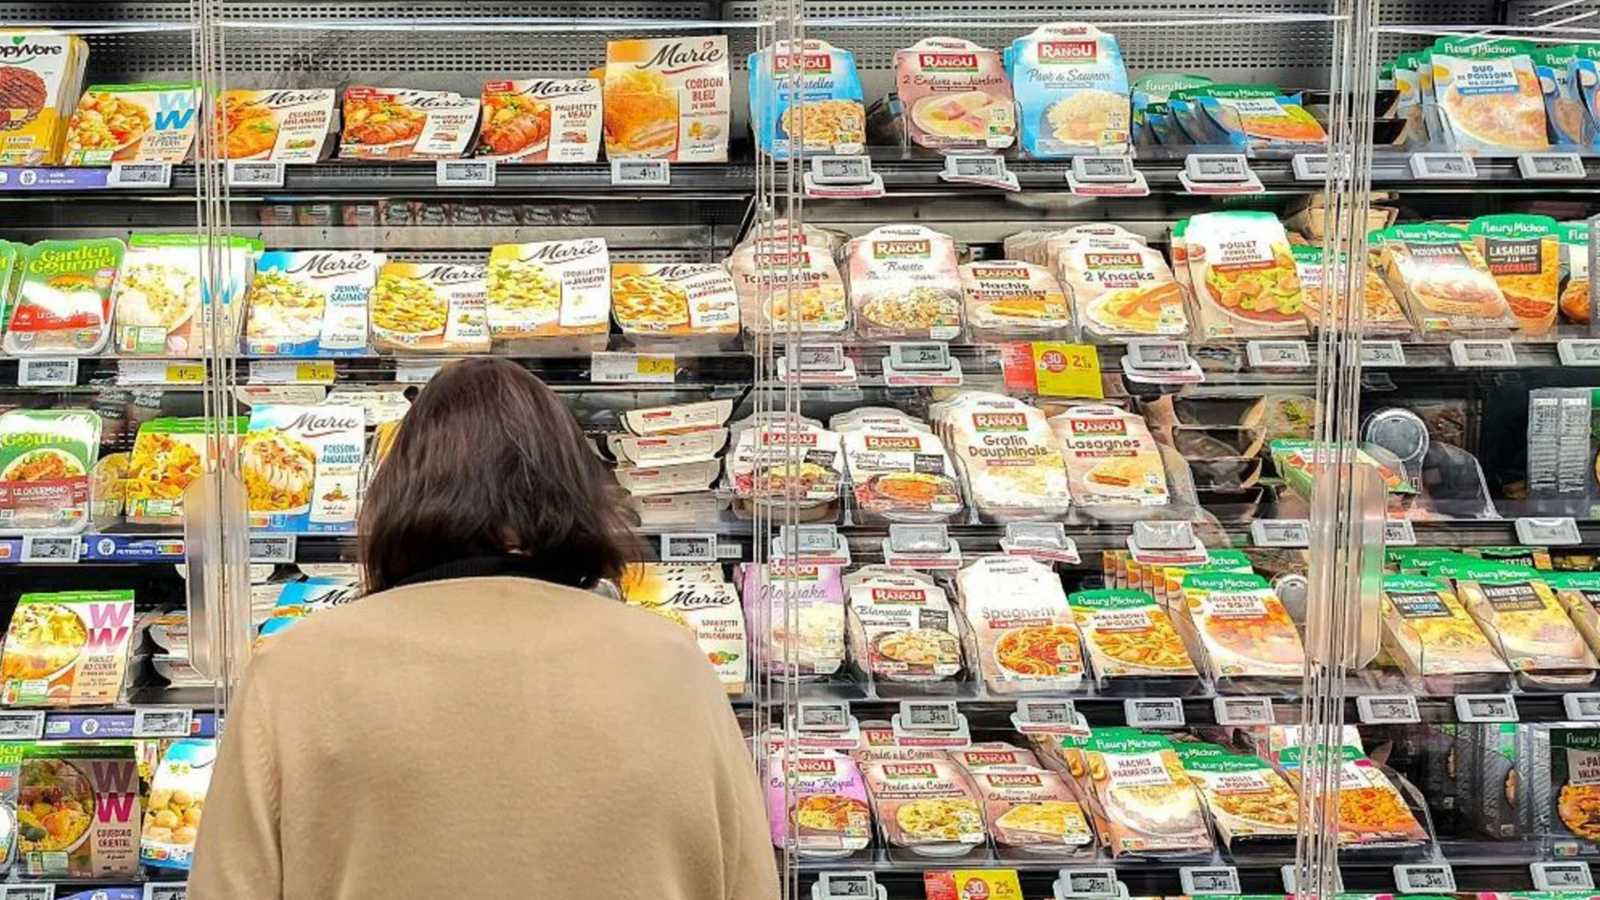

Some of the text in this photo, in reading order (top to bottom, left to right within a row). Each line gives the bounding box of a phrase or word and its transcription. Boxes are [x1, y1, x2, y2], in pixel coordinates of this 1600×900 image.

[1041, 42, 1092, 58] RANOU
[1478, 44, 1516, 54] Michon
[635, 43, 724, 69] Marie
[921, 54, 978, 68] RANOU
[1472, 65, 1494, 73] DUO
[1467, 72, 1513, 81] POISSONS
[510, 81, 595, 96] Marie
[685, 77, 724, 90] CORDON
[248, 90, 330, 105] Marie
[692, 90, 716, 101] BLEU
[155, 109, 194, 130] W
[1481, 222, 1548, 233] Fleury Michon
[875, 241, 926, 253] RANOU
[1219, 240, 1257, 249] POULET
[41, 246, 110, 262] Garden
[520, 243, 602, 261] Marie
[1490, 246, 1537, 257] LASAGNES
[29, 257, 117, 275] Gourmet
[286, 253, 370, 273] Marie
[1088, 254, 1138, 266] RANOU
[974, 269, 1026, 278] RANOU
[1085, 271, 1155, 281] 2 Knacks
[277, 413, 359, 431] Marie
[977, 414, 1025, 426] RANOU
[1074, 421, 1122, 432] RANOU
[869, 438, 917, 448] RANOU
[982, 435, 1028, 445] Gratin
[1066, 438, 1141, 450] Lasagnes
[323, 444, 355, 453] POISSON
[968, 447, 1048, 459] Dauphinois
[657, 590, 735, 606] Marie
[876, 590, 922, 600] RANOU
[89, 603, 131, 627] W
[88, 627, 128, 649] W
[869, 731, 894, 742] RAN
[1566, 733, 1597, 746] Fleury
[1096, 739, 1161, 750] Fleury Michon
[967, 753, 1014, 763] RANOU
[883, 764, 934, 775] RANOU
[1113, 768, 1163, 778] PARMENTIER
[92, 762, 134, 792] W
[988, 774, 1038, 785] RANOU
[96, 792, 135, 823] W
